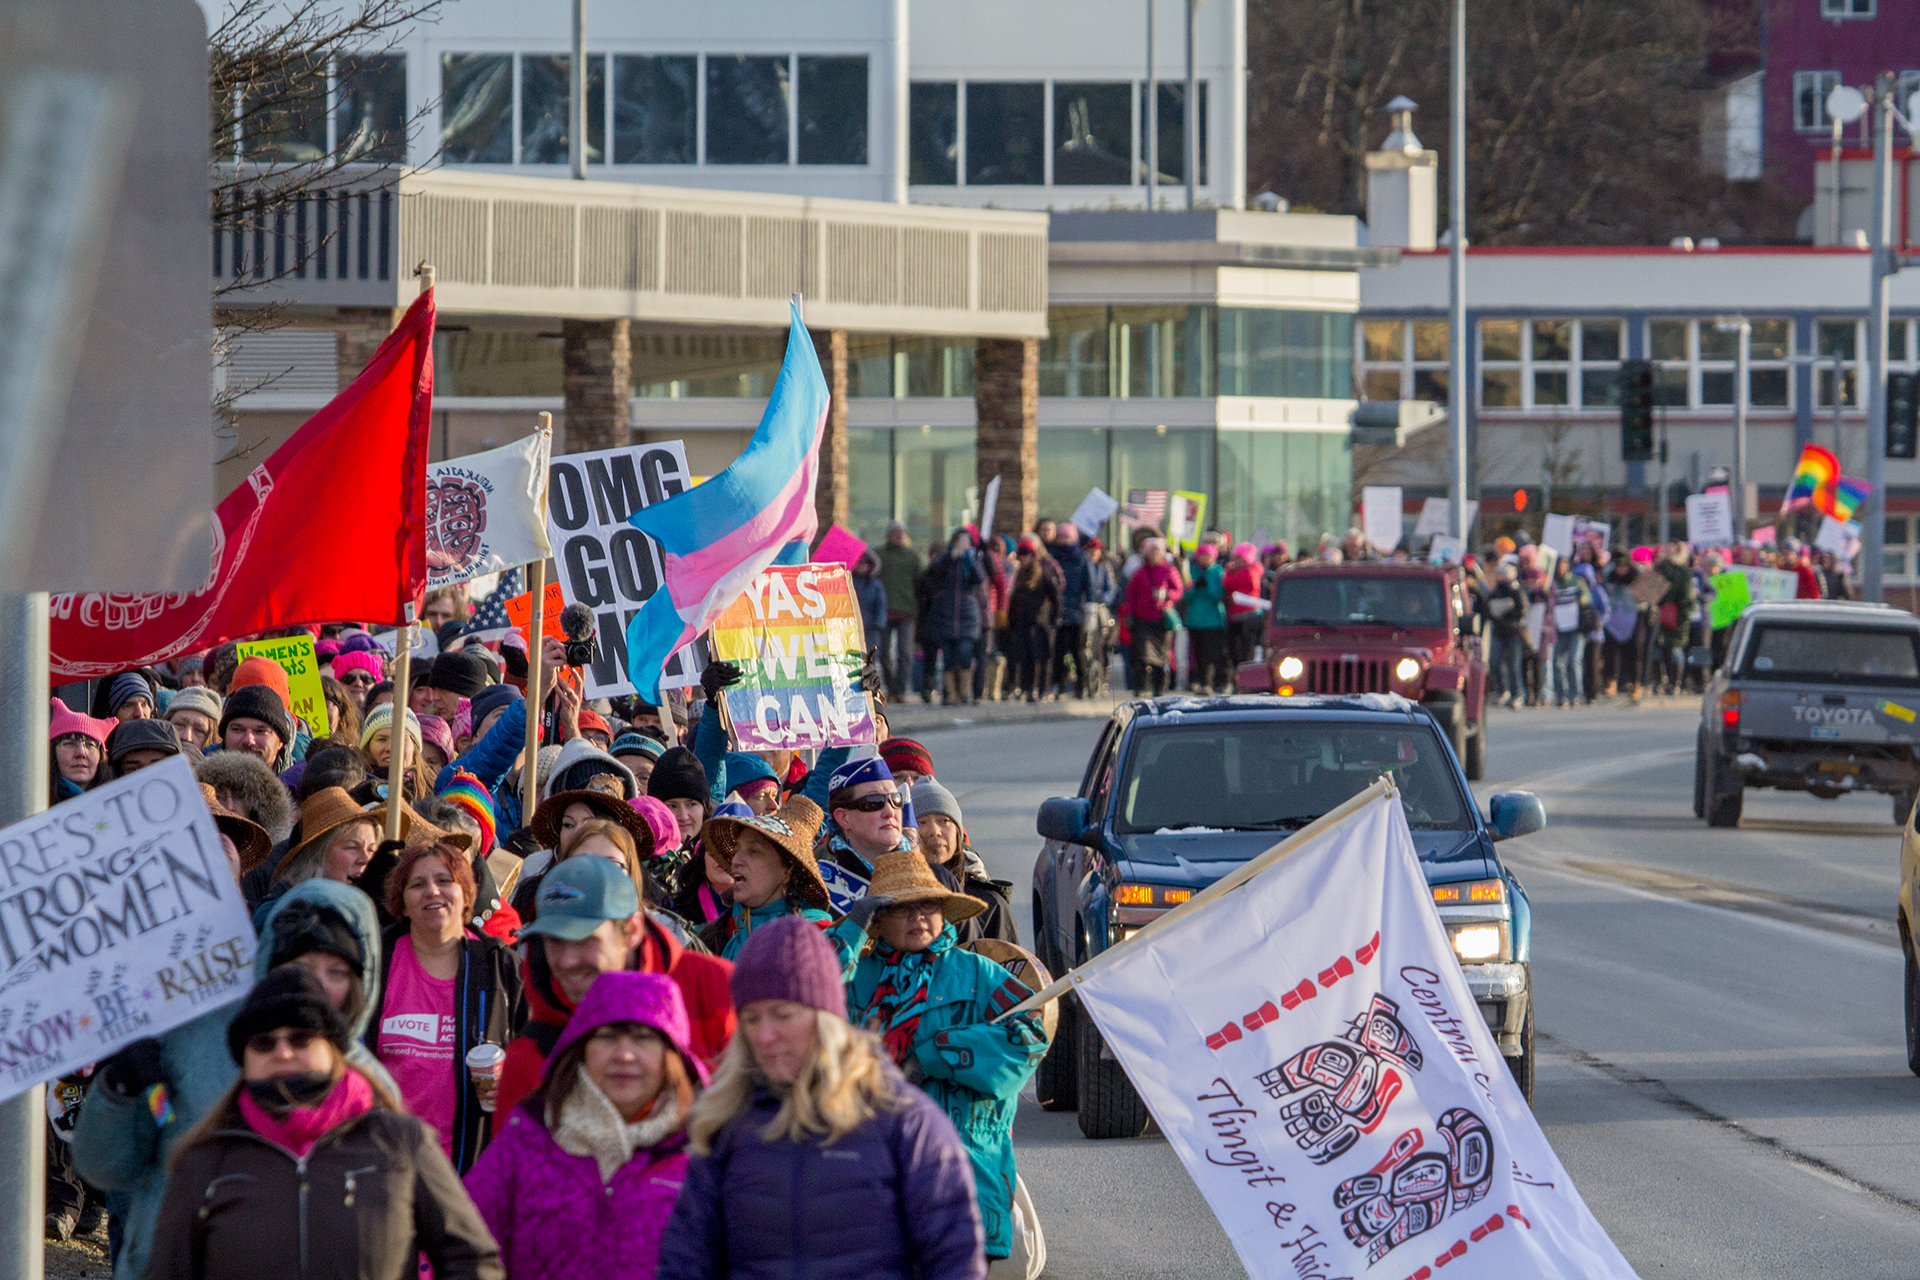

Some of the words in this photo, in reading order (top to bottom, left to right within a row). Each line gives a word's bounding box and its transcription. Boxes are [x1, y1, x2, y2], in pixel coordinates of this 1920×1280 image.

[549, 449, 684, 531] OMG
[564, 528, 667, 608] GO
[744, 571, 826, 620] YAS
[754, 633, 831, 681] WE
[756, 693, 851, 743] CAN
[1792, 706, 1876, 724] TOYOTA
[0, 811, 95, 891] RE'S
[104, 778, 182, 838] TO
[0, 846, 136, 972] TRONG
[36, 821, 222, 972] WOMEN
[93, 984, 137, 1027] BE
[155, 935, 252, 1000] RAISE
[187, 971, 240, 1005] THEM
[97, 1011, 152, 1043] THEM
[398, 1019, 430, 1032] VOTE
[1196, 1076, 1286, 1189] Tlingit
[1265, 1201, 1297, 1230] &
